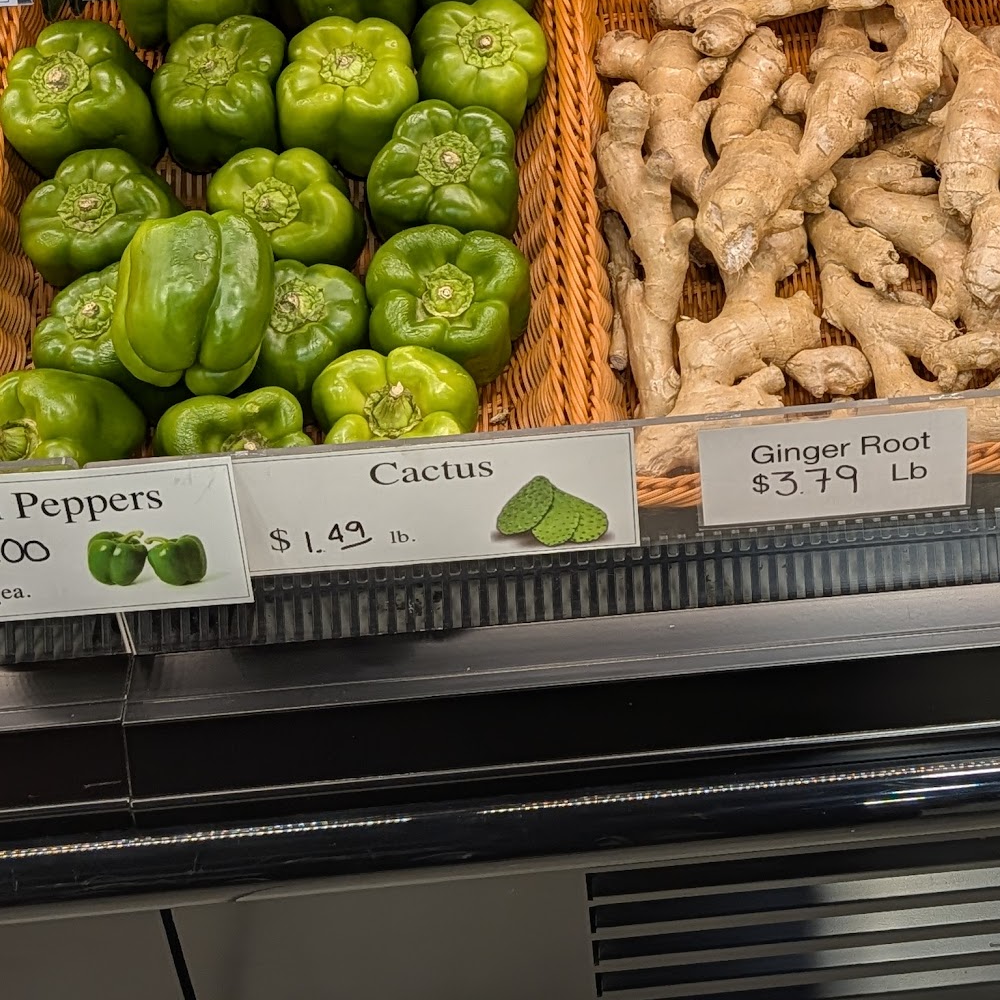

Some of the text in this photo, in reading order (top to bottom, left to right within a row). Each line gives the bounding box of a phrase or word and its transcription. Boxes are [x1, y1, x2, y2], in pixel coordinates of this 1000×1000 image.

[751, 431, 931, 465] Ginger Root
[370, 458, 494, 486] Cactus
[752, 462, 928, 497] $3.79 Lb
[11, 489, 163, 523] Peppers
[389, 530, 416, 544] lb.
